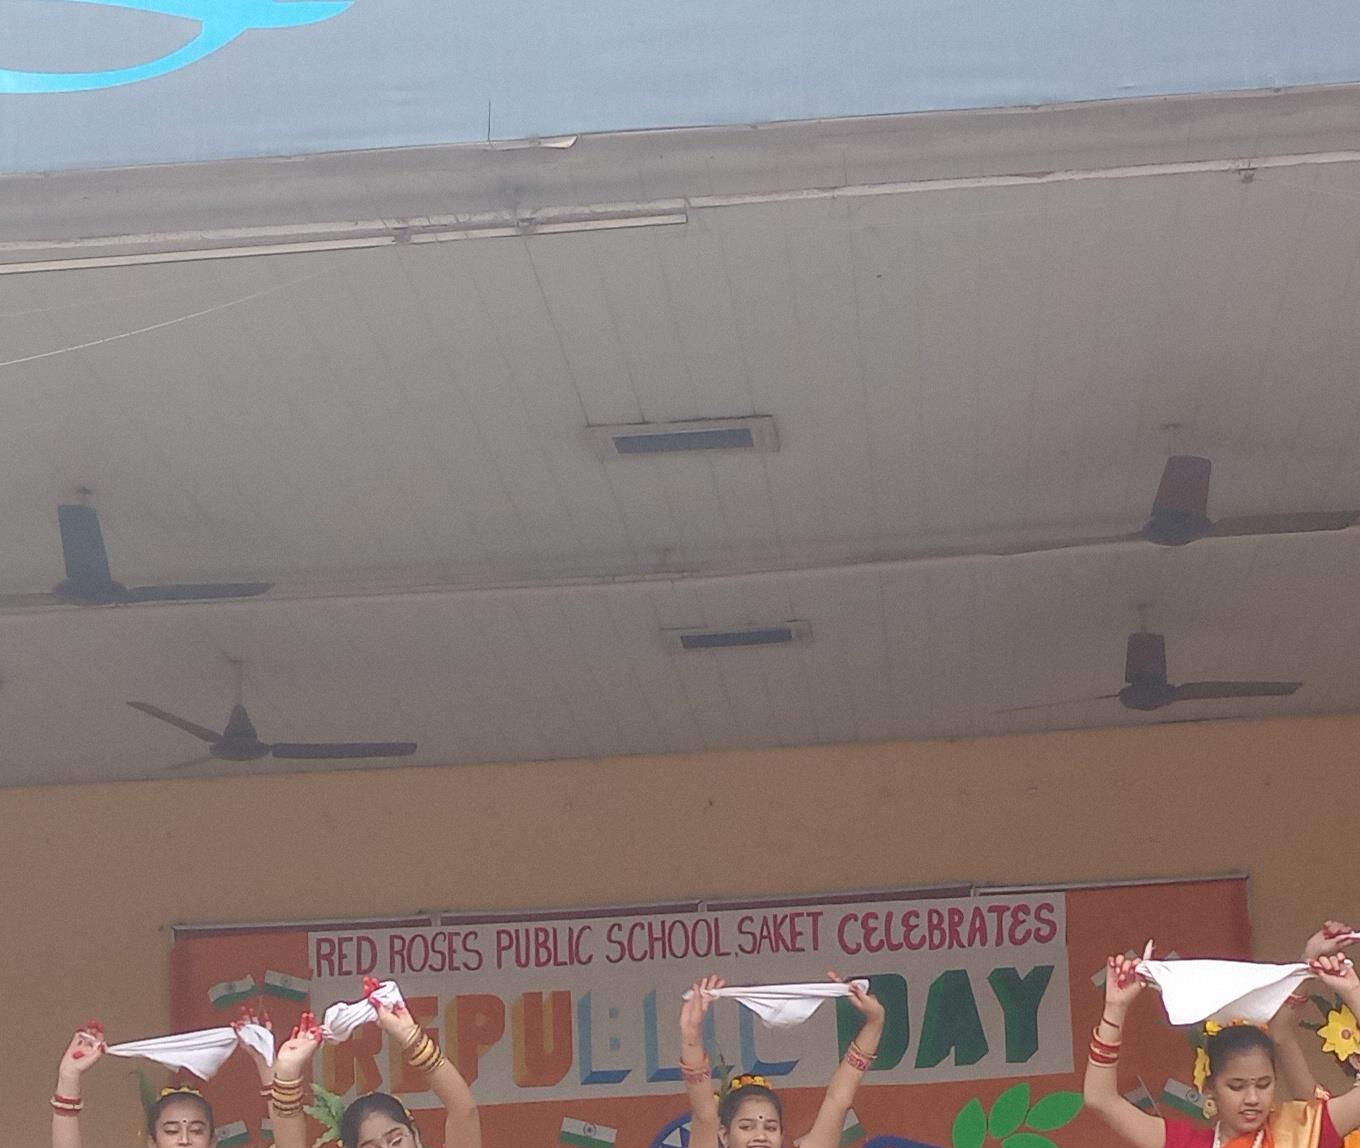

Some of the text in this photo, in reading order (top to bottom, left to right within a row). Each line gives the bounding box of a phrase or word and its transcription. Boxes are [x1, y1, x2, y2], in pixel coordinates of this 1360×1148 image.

[315, 936, 379, 978] RED
[389, 930, 483, 975] ROSES
[496, 925, 594, 970] PUBLIC
[837, 903, 1058, 956] CELEBRATES
[835, 964, 1056, 1071] DAY
